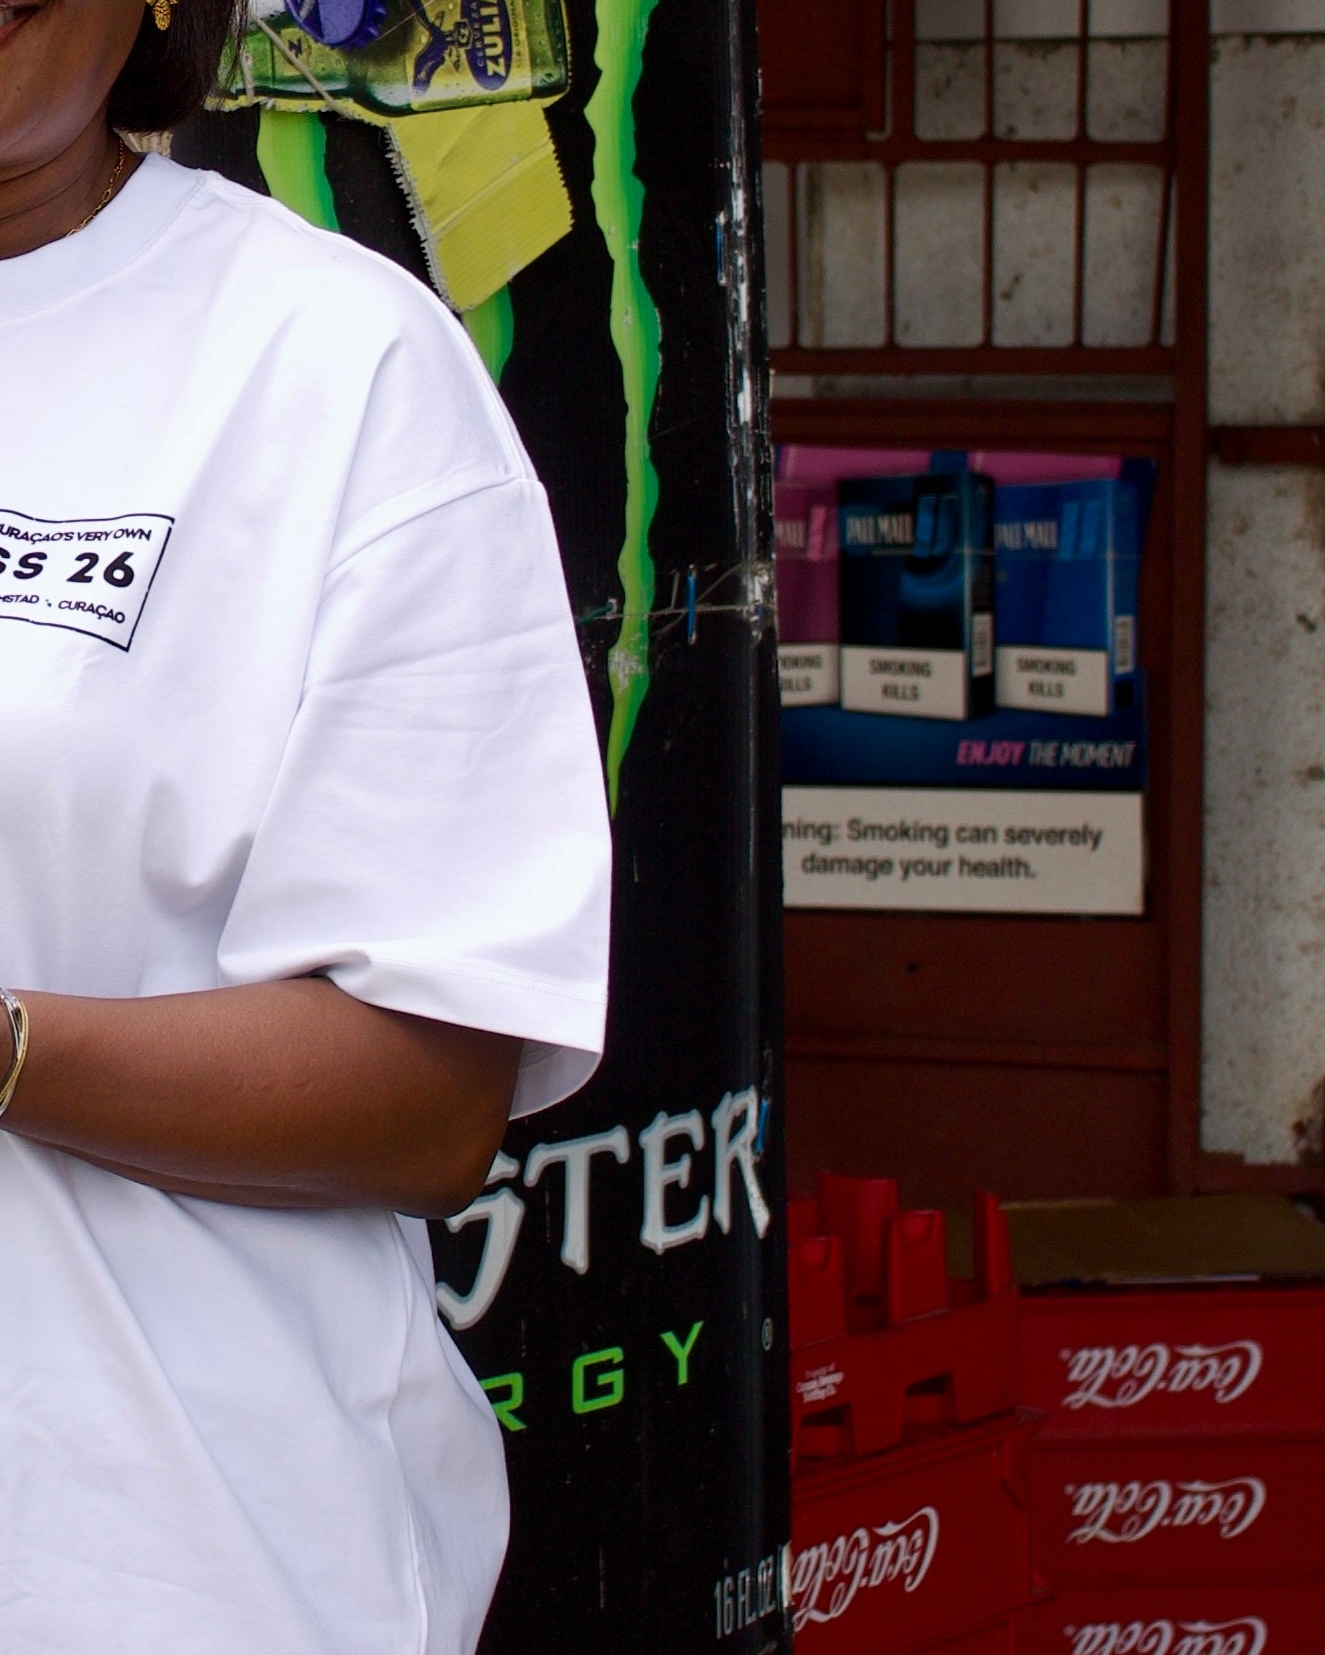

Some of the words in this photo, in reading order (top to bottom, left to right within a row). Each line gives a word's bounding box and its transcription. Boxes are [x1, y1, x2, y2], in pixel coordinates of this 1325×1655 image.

[76, 530, 112, 542] VERY
[112, 528, 152, 541] OWN
[66, 551, 136, 588] 26
[58, 599, 126, 624] CURAÇAO
[868, 658, 933, 679] SMOKING
[1015, 657, 1077, 677] SMOKING
[881, 683, 919, 702] KILLS
[1027, 682, 1065, 699] KILLS
[955, 739, 1027, 766] ENJOY
[1028, 740, 1058, 767] THE
[1059, 741, 1136, 769] MOMENT
[847, 817, 949, 851] Smoking
[955, 823, 998, 845] can
[1003, 824, 1104, 852] severely
[802, 854, 892, 882] damage
[900, 858, 952, 882] your
[958, 855, 1037, 880] health.
[479, 1321, 705, 1432] RGY
[1061, 1339, 1263, 1411] Coca-Cola
[1065, 1475, 1267, 1545] Coca-Cola
